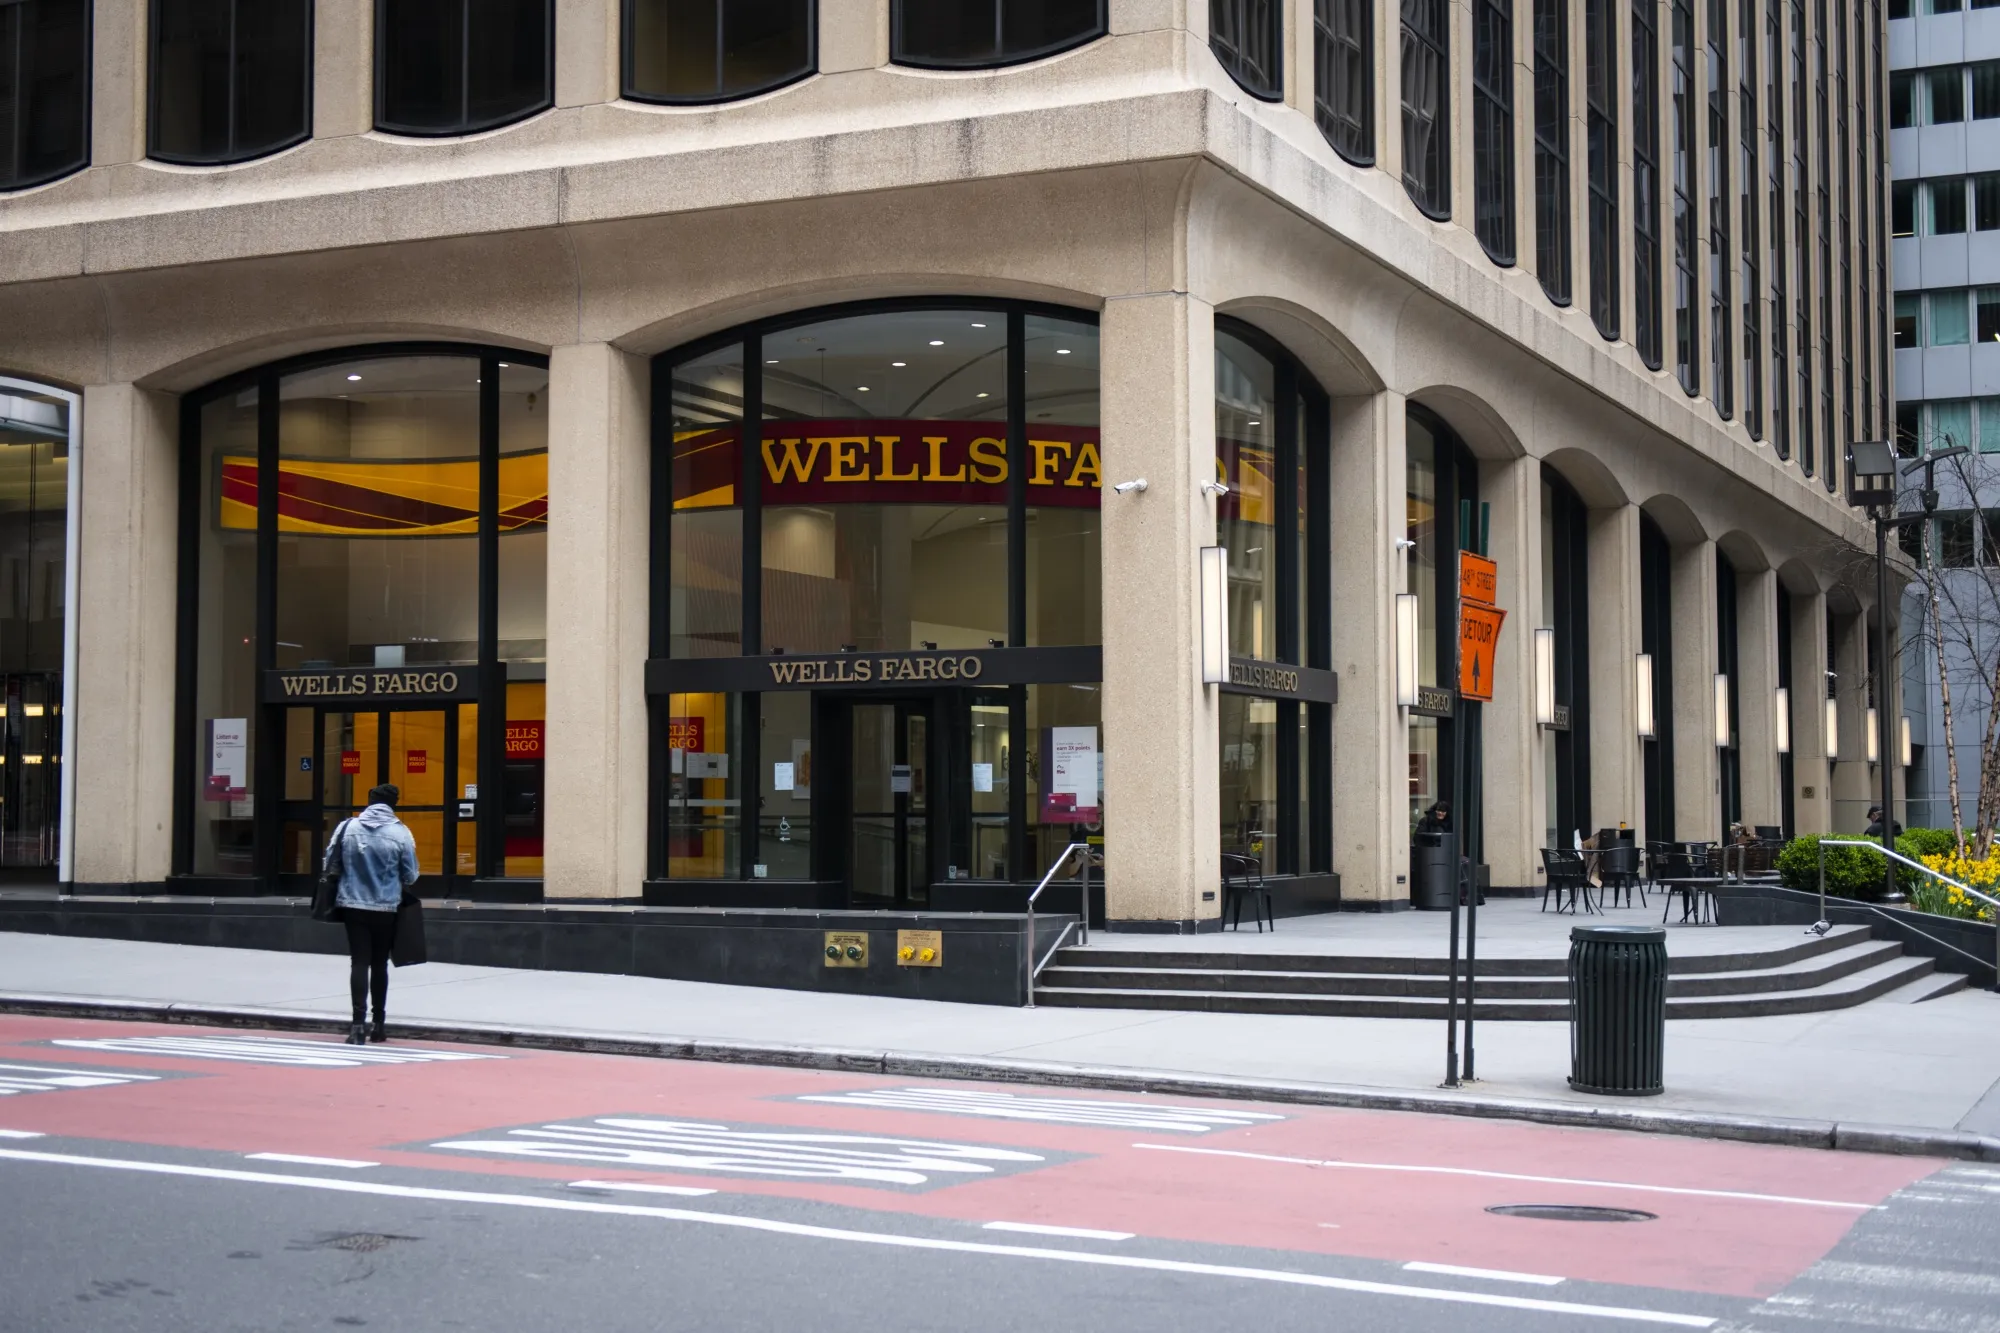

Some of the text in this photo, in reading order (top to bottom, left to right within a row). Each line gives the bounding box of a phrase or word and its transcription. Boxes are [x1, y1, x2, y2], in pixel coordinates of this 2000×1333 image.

[761, 436, 1008, 484] WELLS
[1476, 571, 1496, 591] STREET
[1463, 617, 1493, 645] DETOUR
[769, 656, 982, 684] WELLS FARGO
[1229, 663, 1298, 692] ELLS FARGO
[281, 672, 458, 696] WELLS FARGO
[1424, 692, 1450, 711] FARGO
[505, 727, 539, 739] ELLS
[669, 737, 698, 748] RGO
[505, 740, 539, 751] ARGO
[430, 1118, 1046, 1185] BUS
